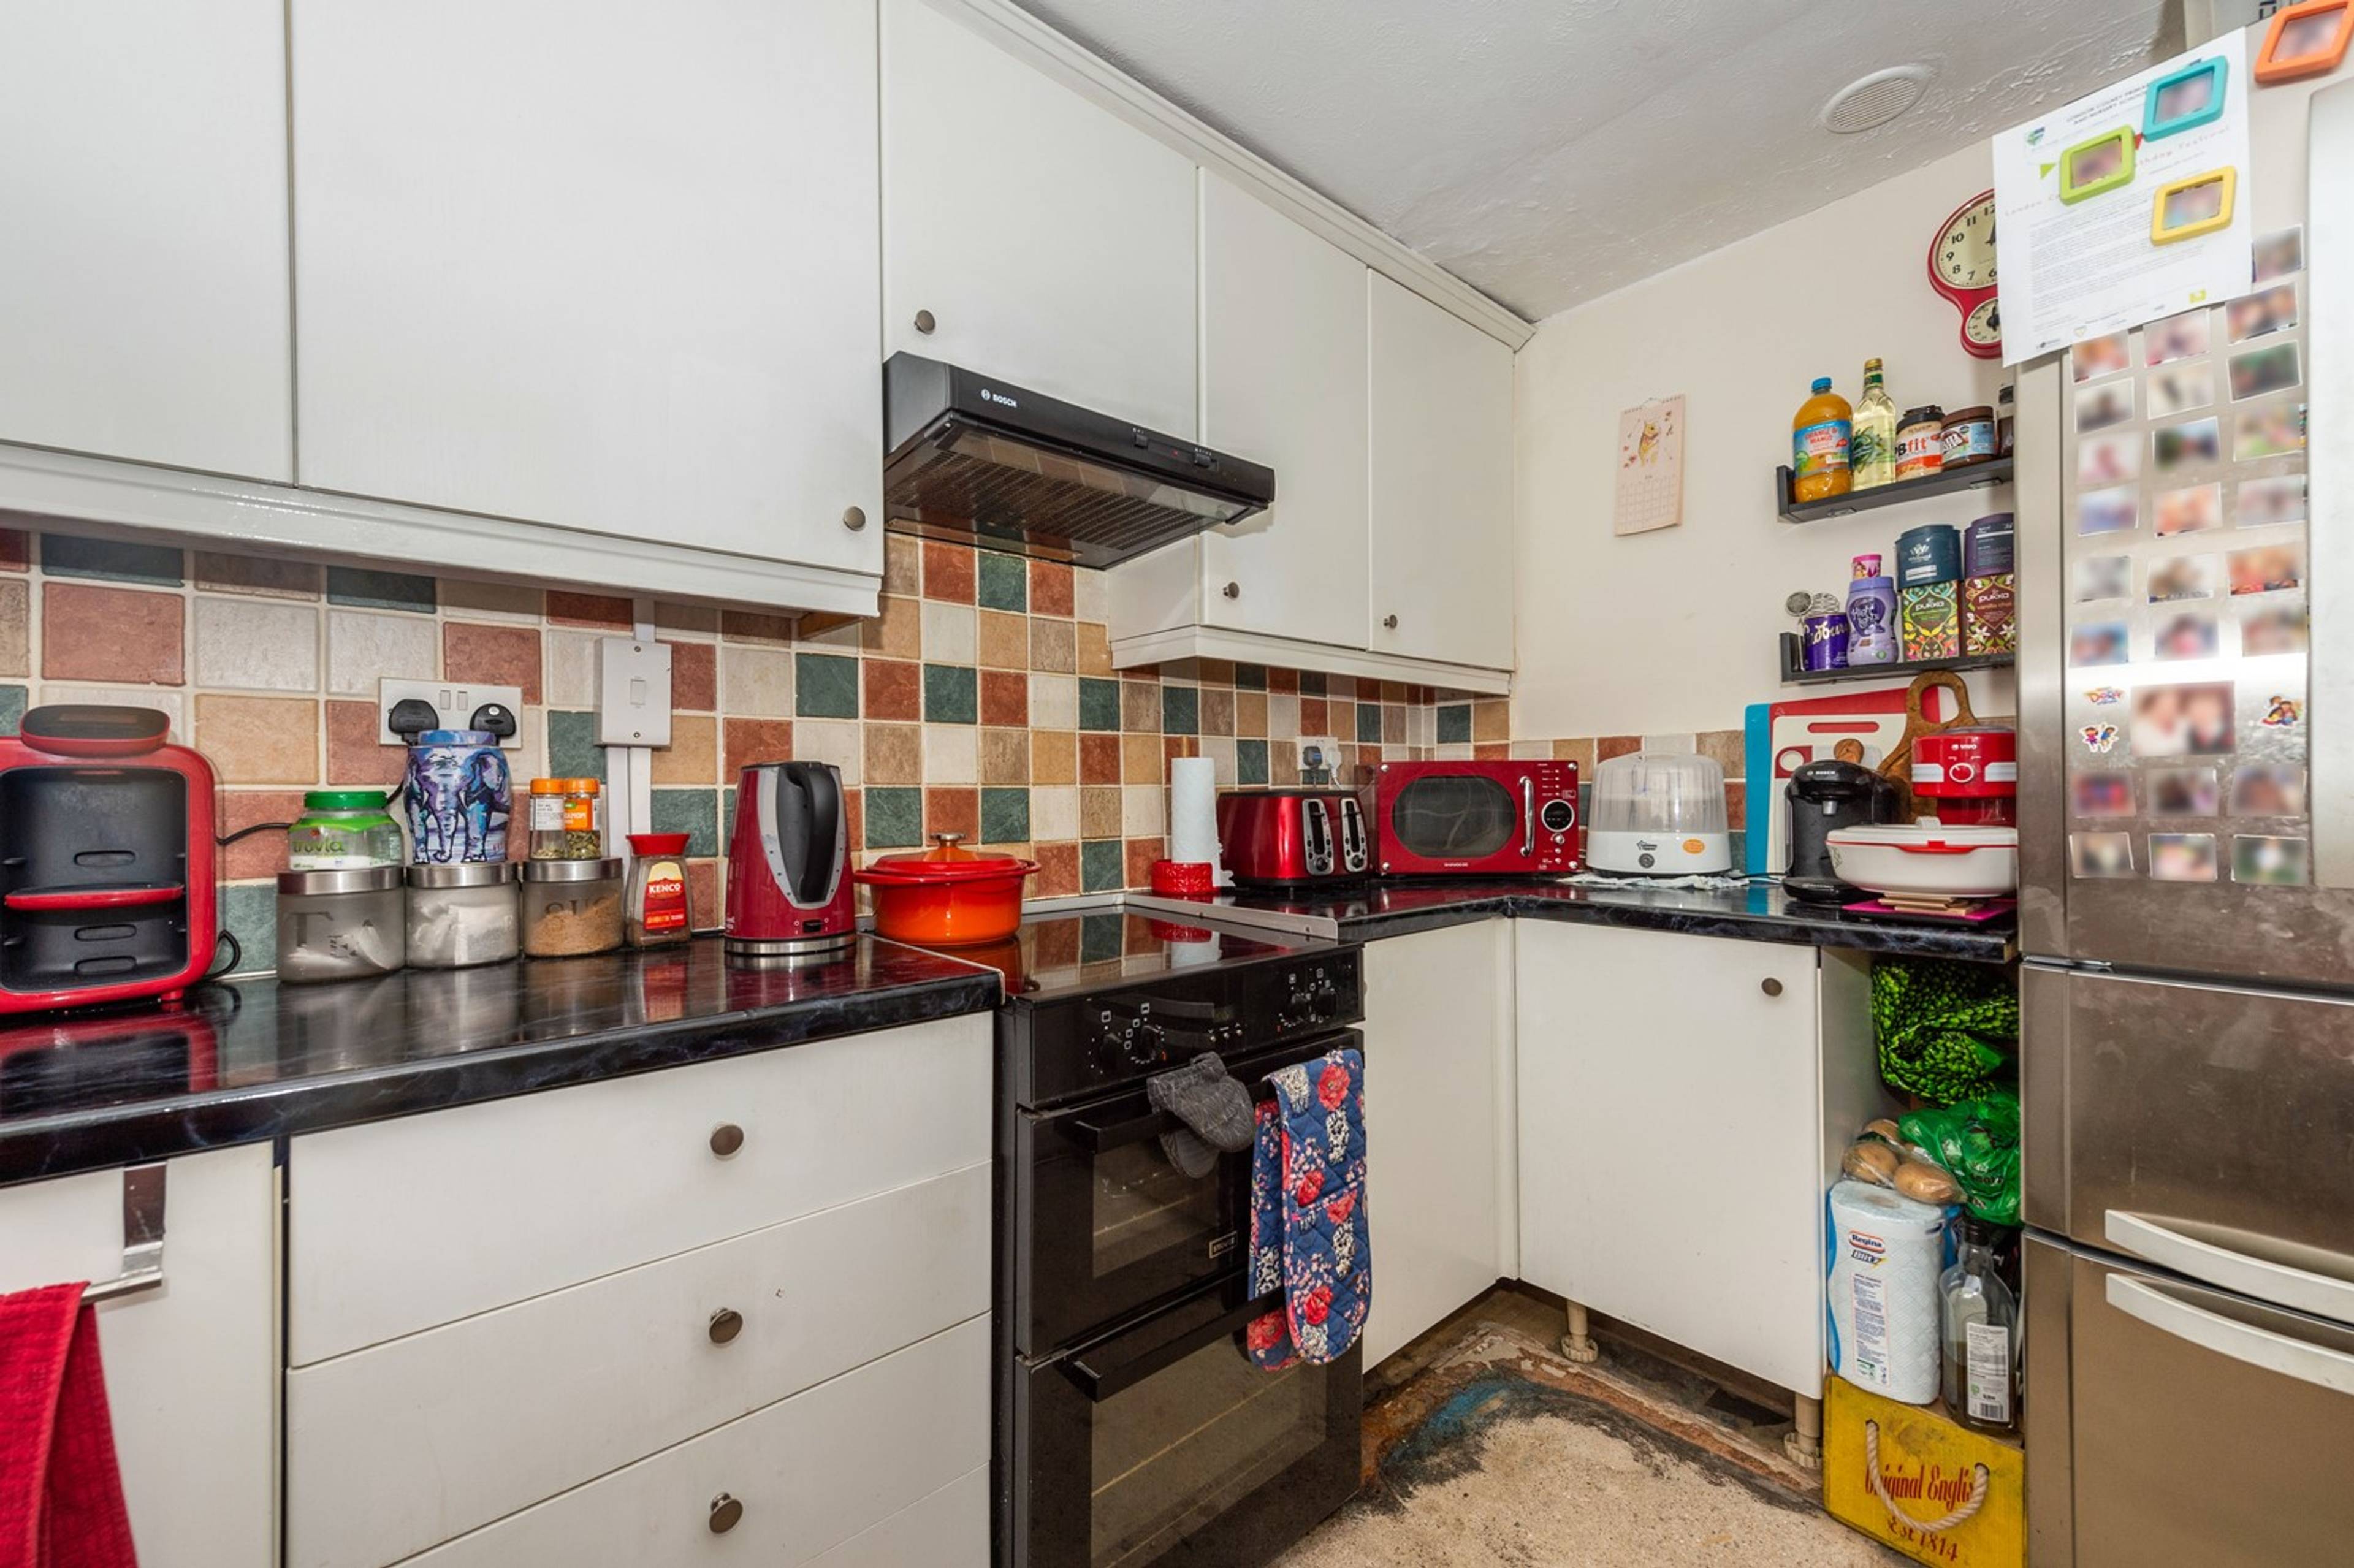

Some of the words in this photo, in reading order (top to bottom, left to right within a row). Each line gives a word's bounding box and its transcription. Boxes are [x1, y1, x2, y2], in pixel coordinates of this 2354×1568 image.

[1966, 215, 1977, 227] 11
[1951, 232, 1964, 244] 10
[1946, 251, 1955, 261] 9
[1952, 264, 1961, 275] 8
[1967, 270, 1976, 280] 7
[1988, 268, 1997, 278] 6
[992, 393, 1017, 408] BOSCH
[649, 883, 681, 894] KENCO
[1852, 1234, 1881, 1248] Regina
[1920, 1532, 1958, 1562] 1814
